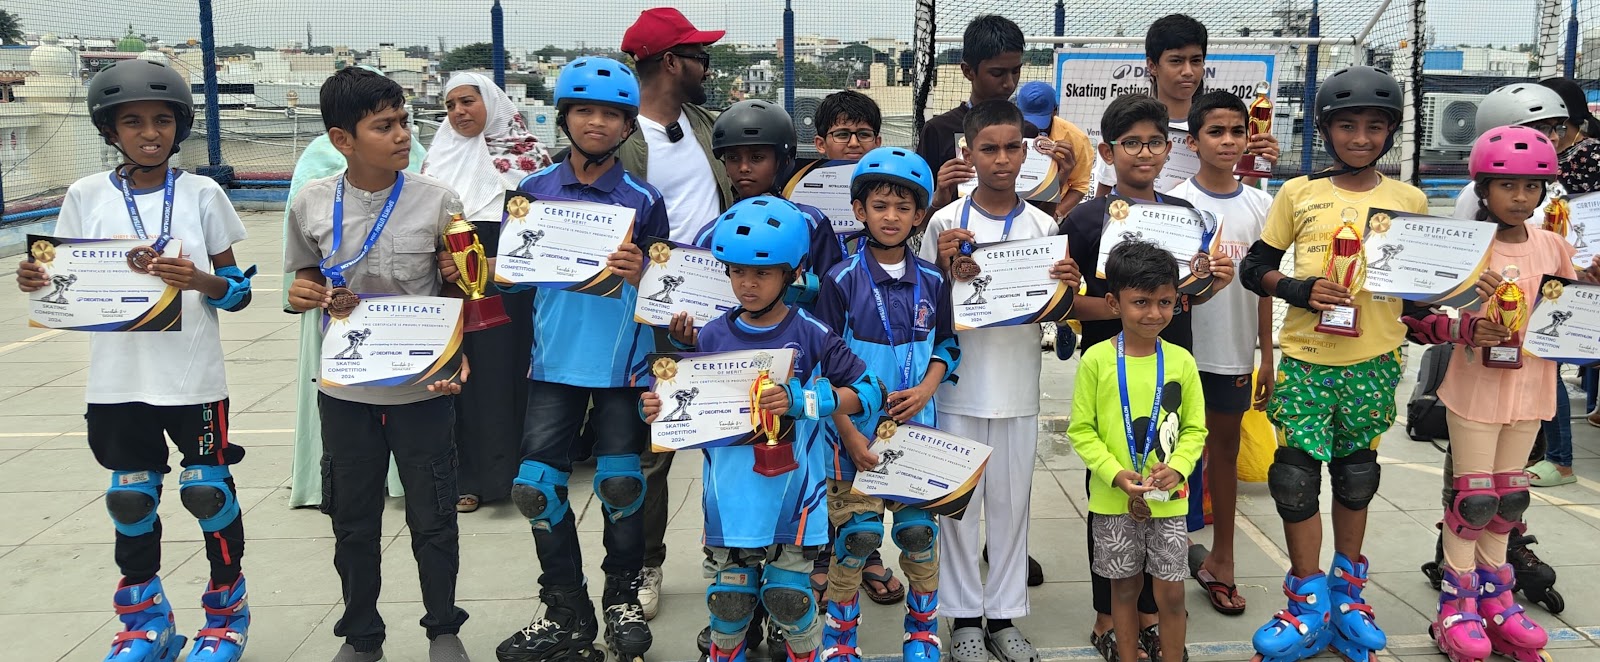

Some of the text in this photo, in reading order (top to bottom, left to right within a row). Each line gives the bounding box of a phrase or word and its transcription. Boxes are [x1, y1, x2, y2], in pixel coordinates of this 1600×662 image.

[1066, 83, 1106, 100] Skating
[382, 200, 394, 219] SPORTS
[544, 207, 612, 224] CERTIFICATE
[1142, 211, 1204, 227] CERTIFICATE
[1405, 223, 1473, 238] CERTIFICATE
[987, 247, 1050, 259] CERTIFICATE
[501, 264, 536, 272] COMPETITION
[368, 305, 441, 314] CERTIFICATE
[1529, 340, 1560, 349] COMPETITION
[908, 431, 970, 456] CERTIFICATE
[859, 478, 888, 486] COMPETITION
